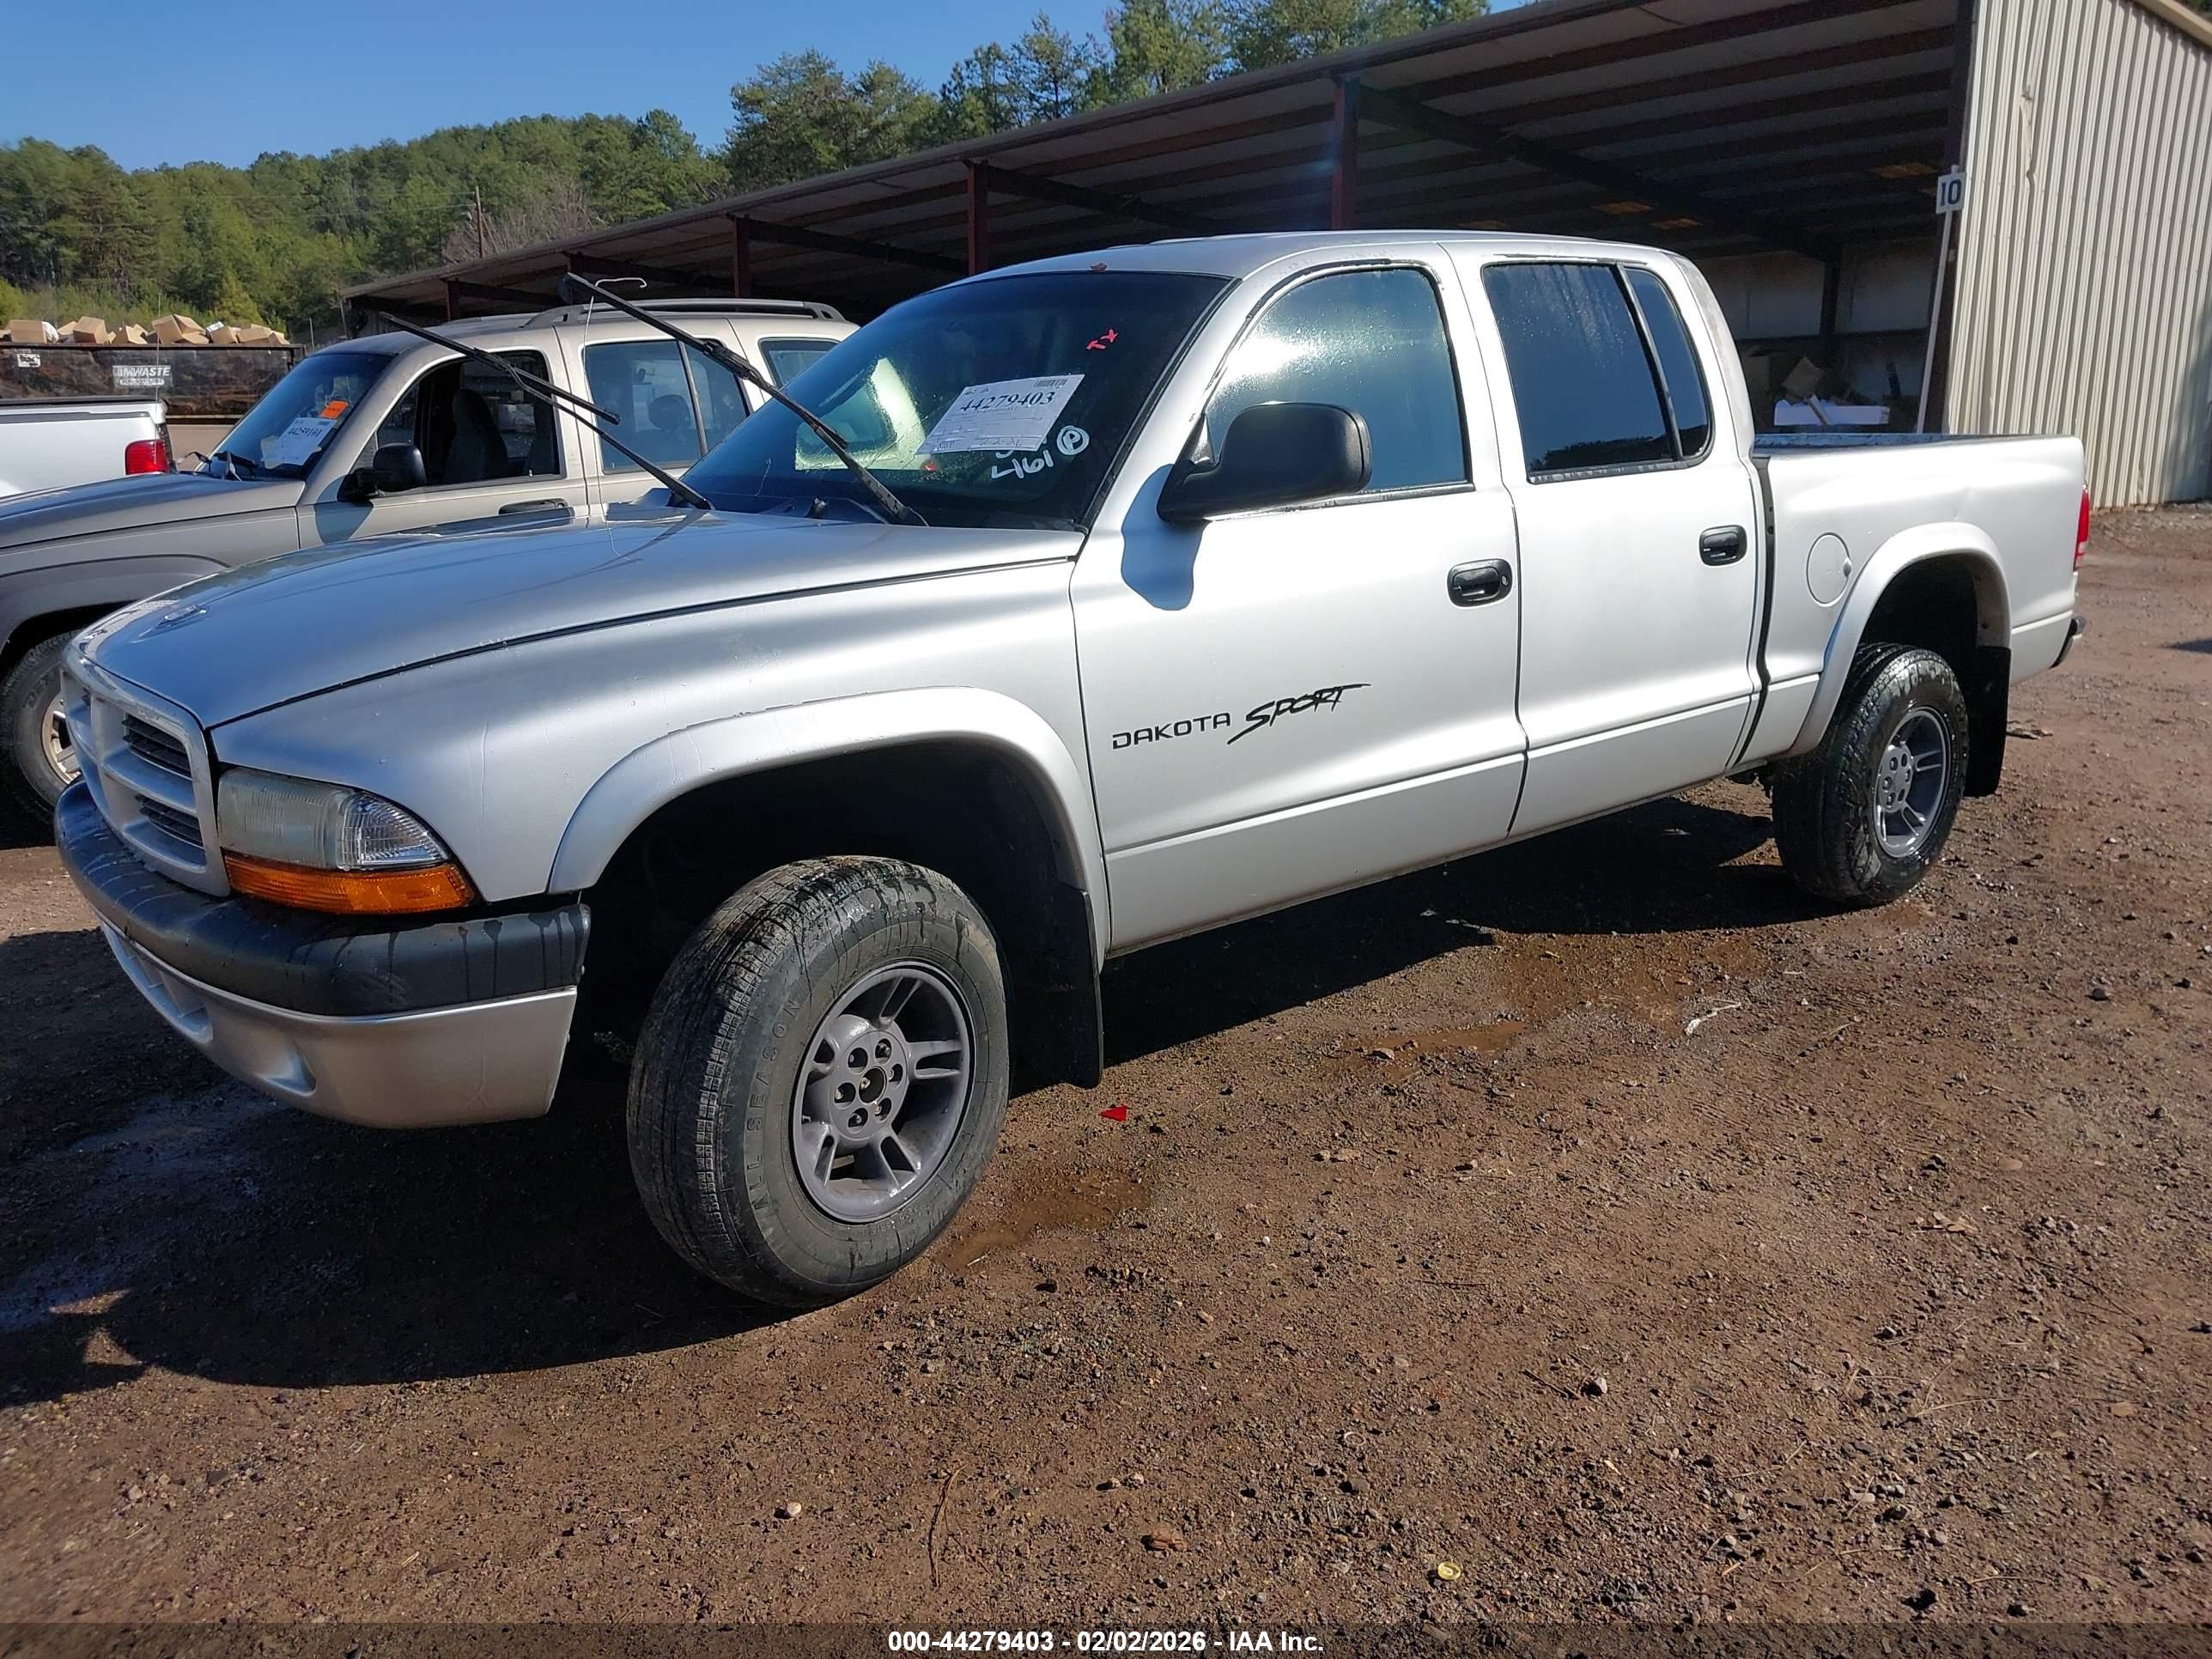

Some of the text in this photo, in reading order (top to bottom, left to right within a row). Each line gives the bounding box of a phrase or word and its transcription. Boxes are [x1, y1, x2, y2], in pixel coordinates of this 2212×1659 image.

[1941, 179, 1962, 206] 10
[960, 392, 1055, 411] 44279403
[991, 450, 1054, 478] 461
[1112, 683, 1372, 750] DAKOTA SPORT
[746, 1000, 800, 1211] ALL SEASON
